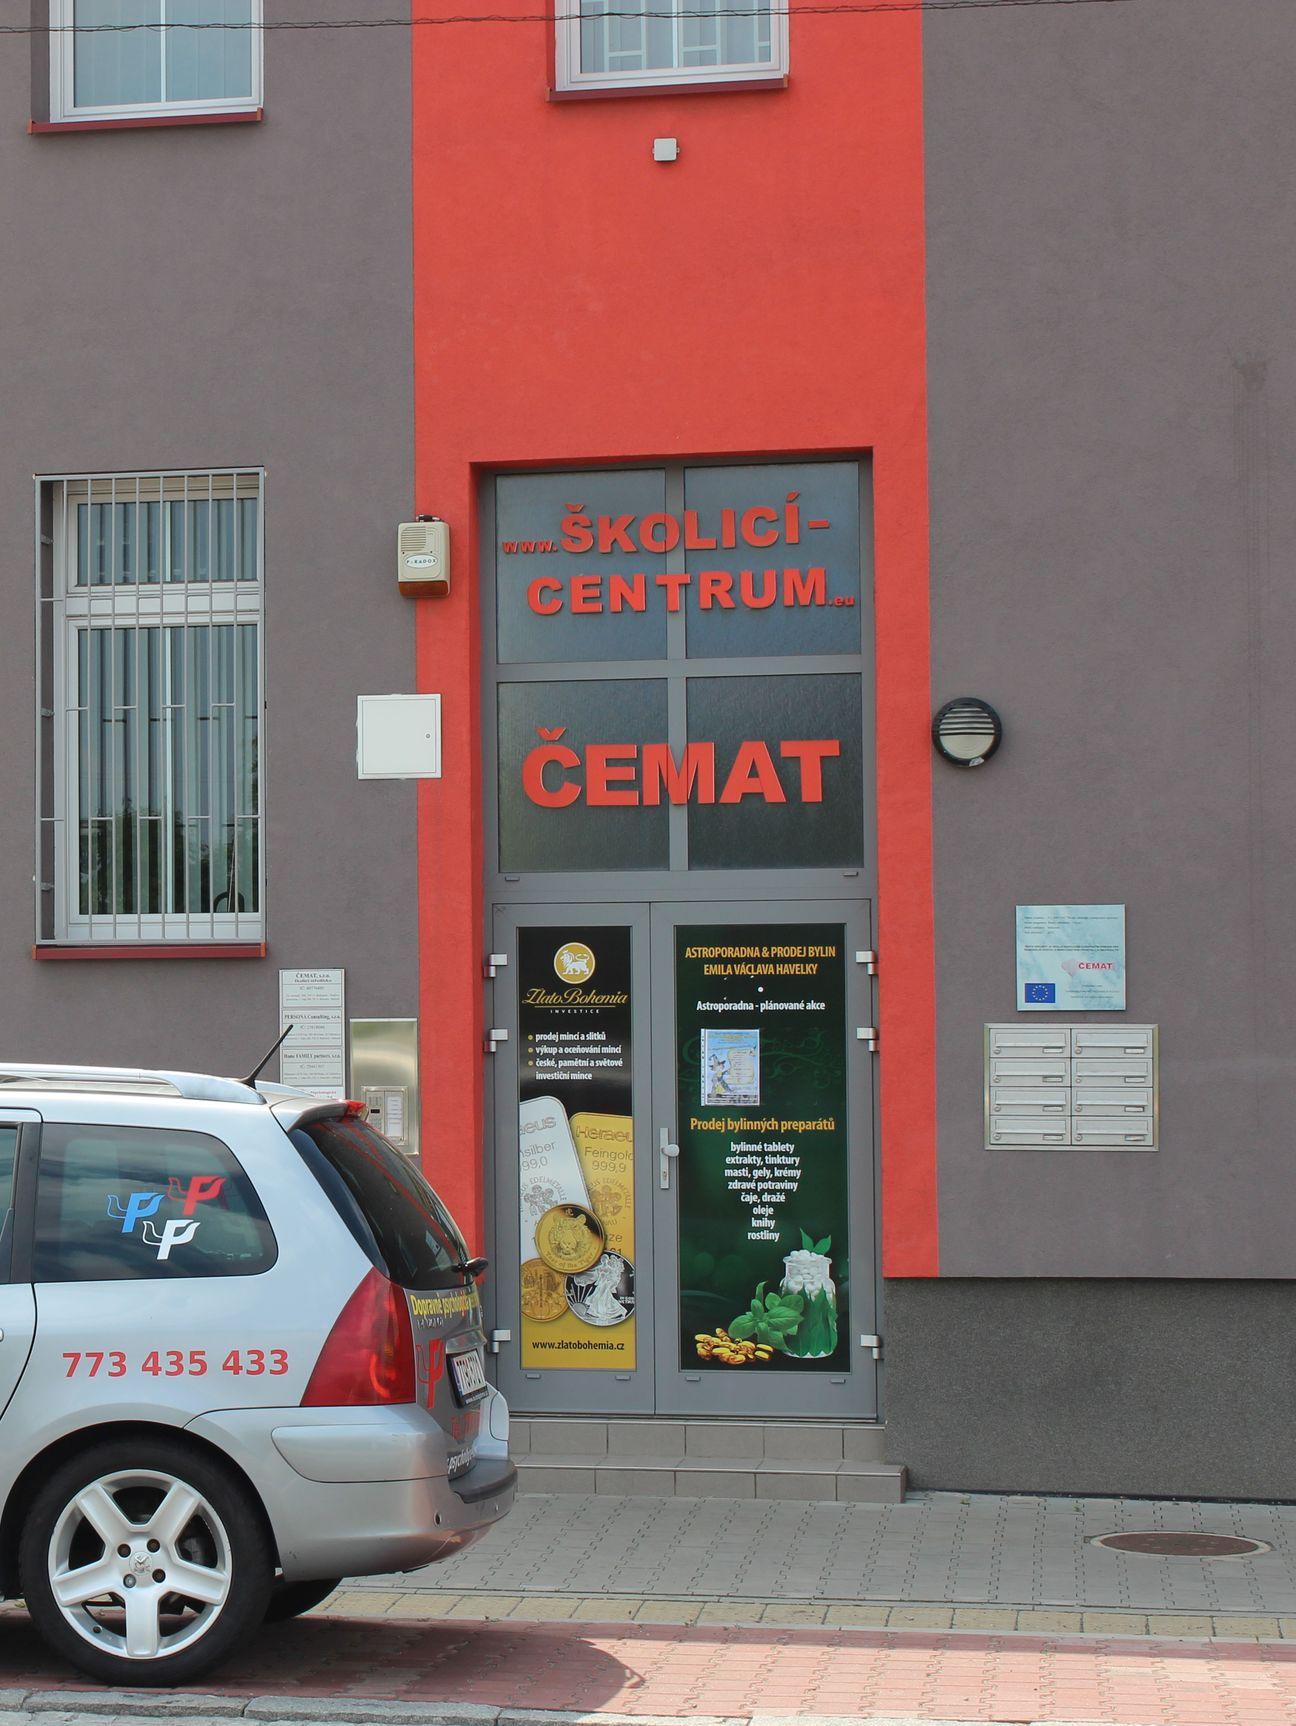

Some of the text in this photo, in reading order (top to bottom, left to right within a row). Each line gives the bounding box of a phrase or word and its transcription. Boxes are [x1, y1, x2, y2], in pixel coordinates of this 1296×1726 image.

[521, 727, 841, 807] ČEMAT
[685, 946, 836, 958] ASTROPORADNA & PRODEJ BYLIN
[704, 962, 818, 976] EMILA VÁCLAVA HAVELKY
[696, 1001, 754, 1013] Astroporadna
[760, 1000, 805, 1013] plánované
[806, 1001, 826, 1010] akce
[535, 1032, 559, 1042] prodej
[560, 1032, 580, 1041] mincí
[586, 1031, 606, 1041] slitků
[535, 1045, 558, 1055] výkup
[564, 1045, 601, 1054] oceňování
[601, 1045, 622, 1054] mincí
[535, 1058, 557, 1068] české,
[558, 1058, 589, 1068] pamětní
[595, 1058, 623, 1067] světové
[535, 1071, 593, 1080] investiční mince
[690, 1117, 835, 1133] Prodej bylinných preparátů
[730, 1142, 795, 1154] bylinné tablety
[592, 1160, 627, 1173] 999,9
[725, 1155, 800, 1167] extrakty, tinktury
[724, 1167, 802, 1179] masti, gely, krémy
[728, 1180, 798, 1192] zdravé potraviny
[740, 1192, 786, 1205] čaje, dražé
[752, 1205, 774, 1217] oleje
[751, 1217, 776, 1229] knihy
[747, 1230, 780, 1242] rostliny
[532, 1340, 625, 1350] www.zlatobohemia.cz
[62, 1349, 289, 1377] 773 435 433
